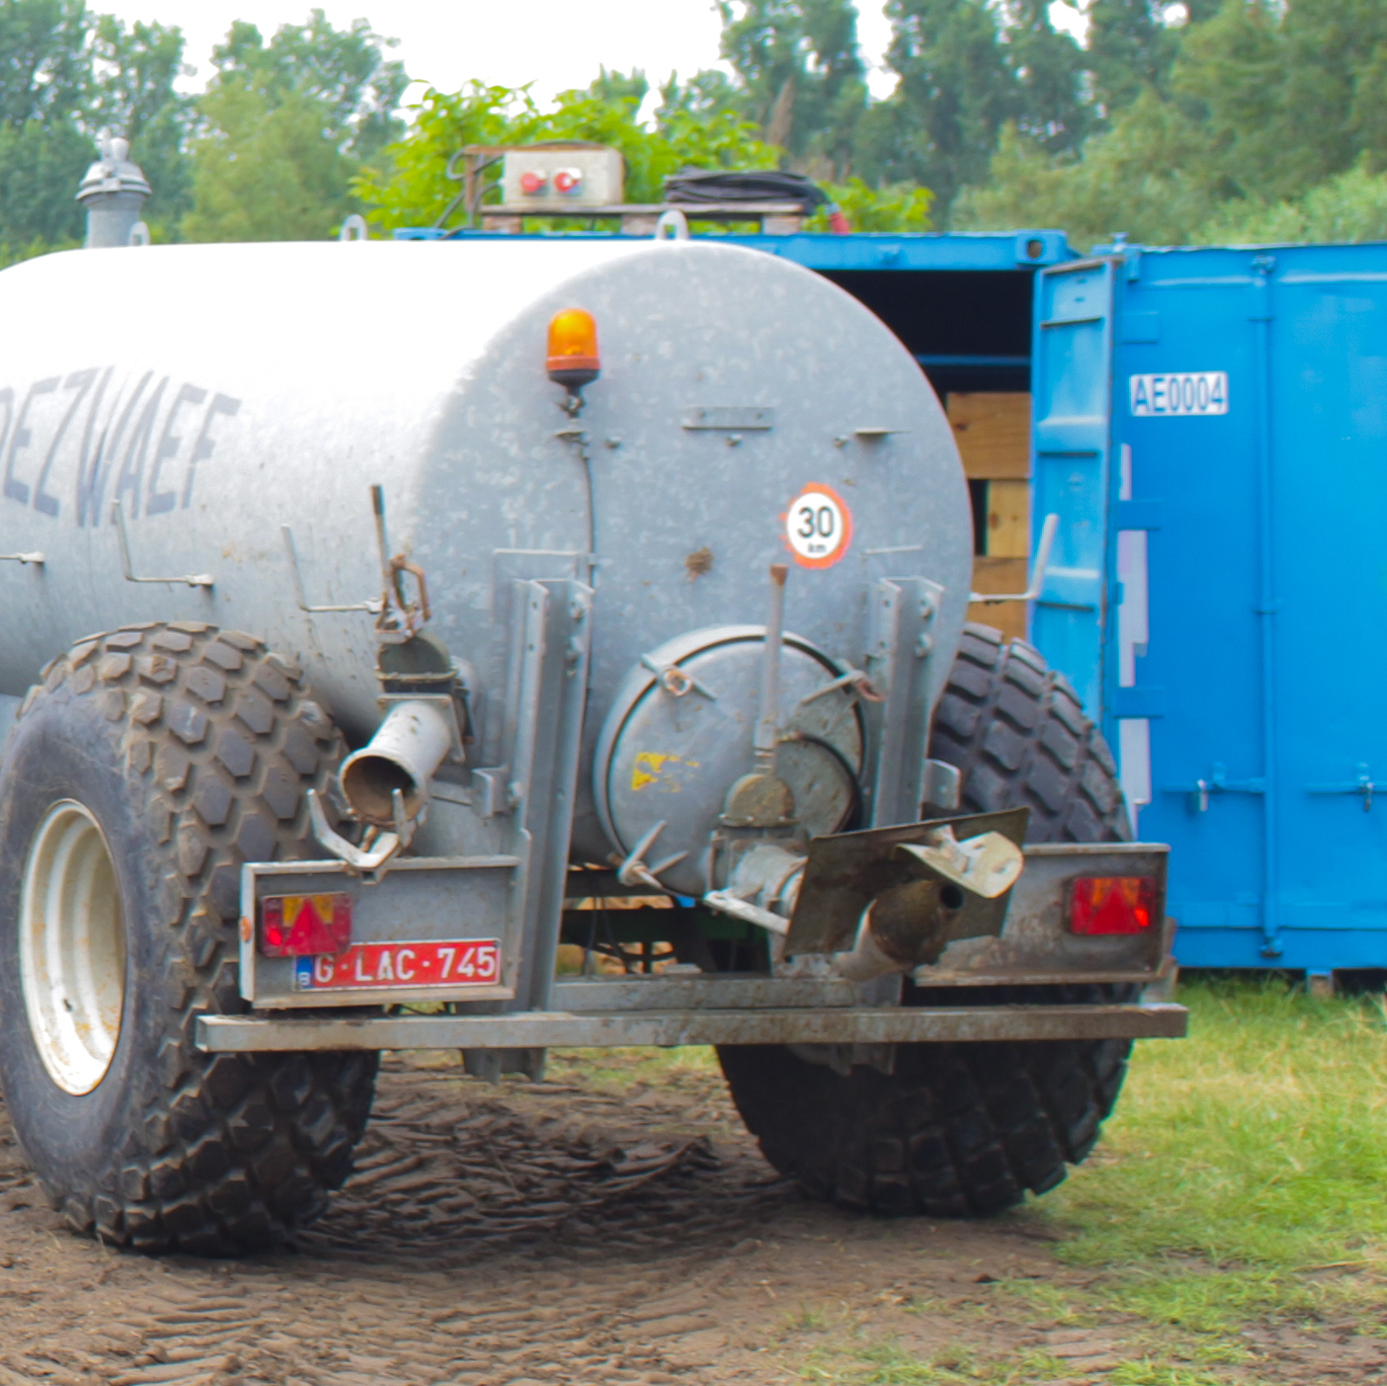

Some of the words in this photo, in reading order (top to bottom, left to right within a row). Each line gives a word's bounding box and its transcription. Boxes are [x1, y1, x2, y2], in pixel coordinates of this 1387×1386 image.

[1131, 377, 1224, 412] AE0004
[797, 505, 835, 539] 30
[808, 542, 827, 553] km
